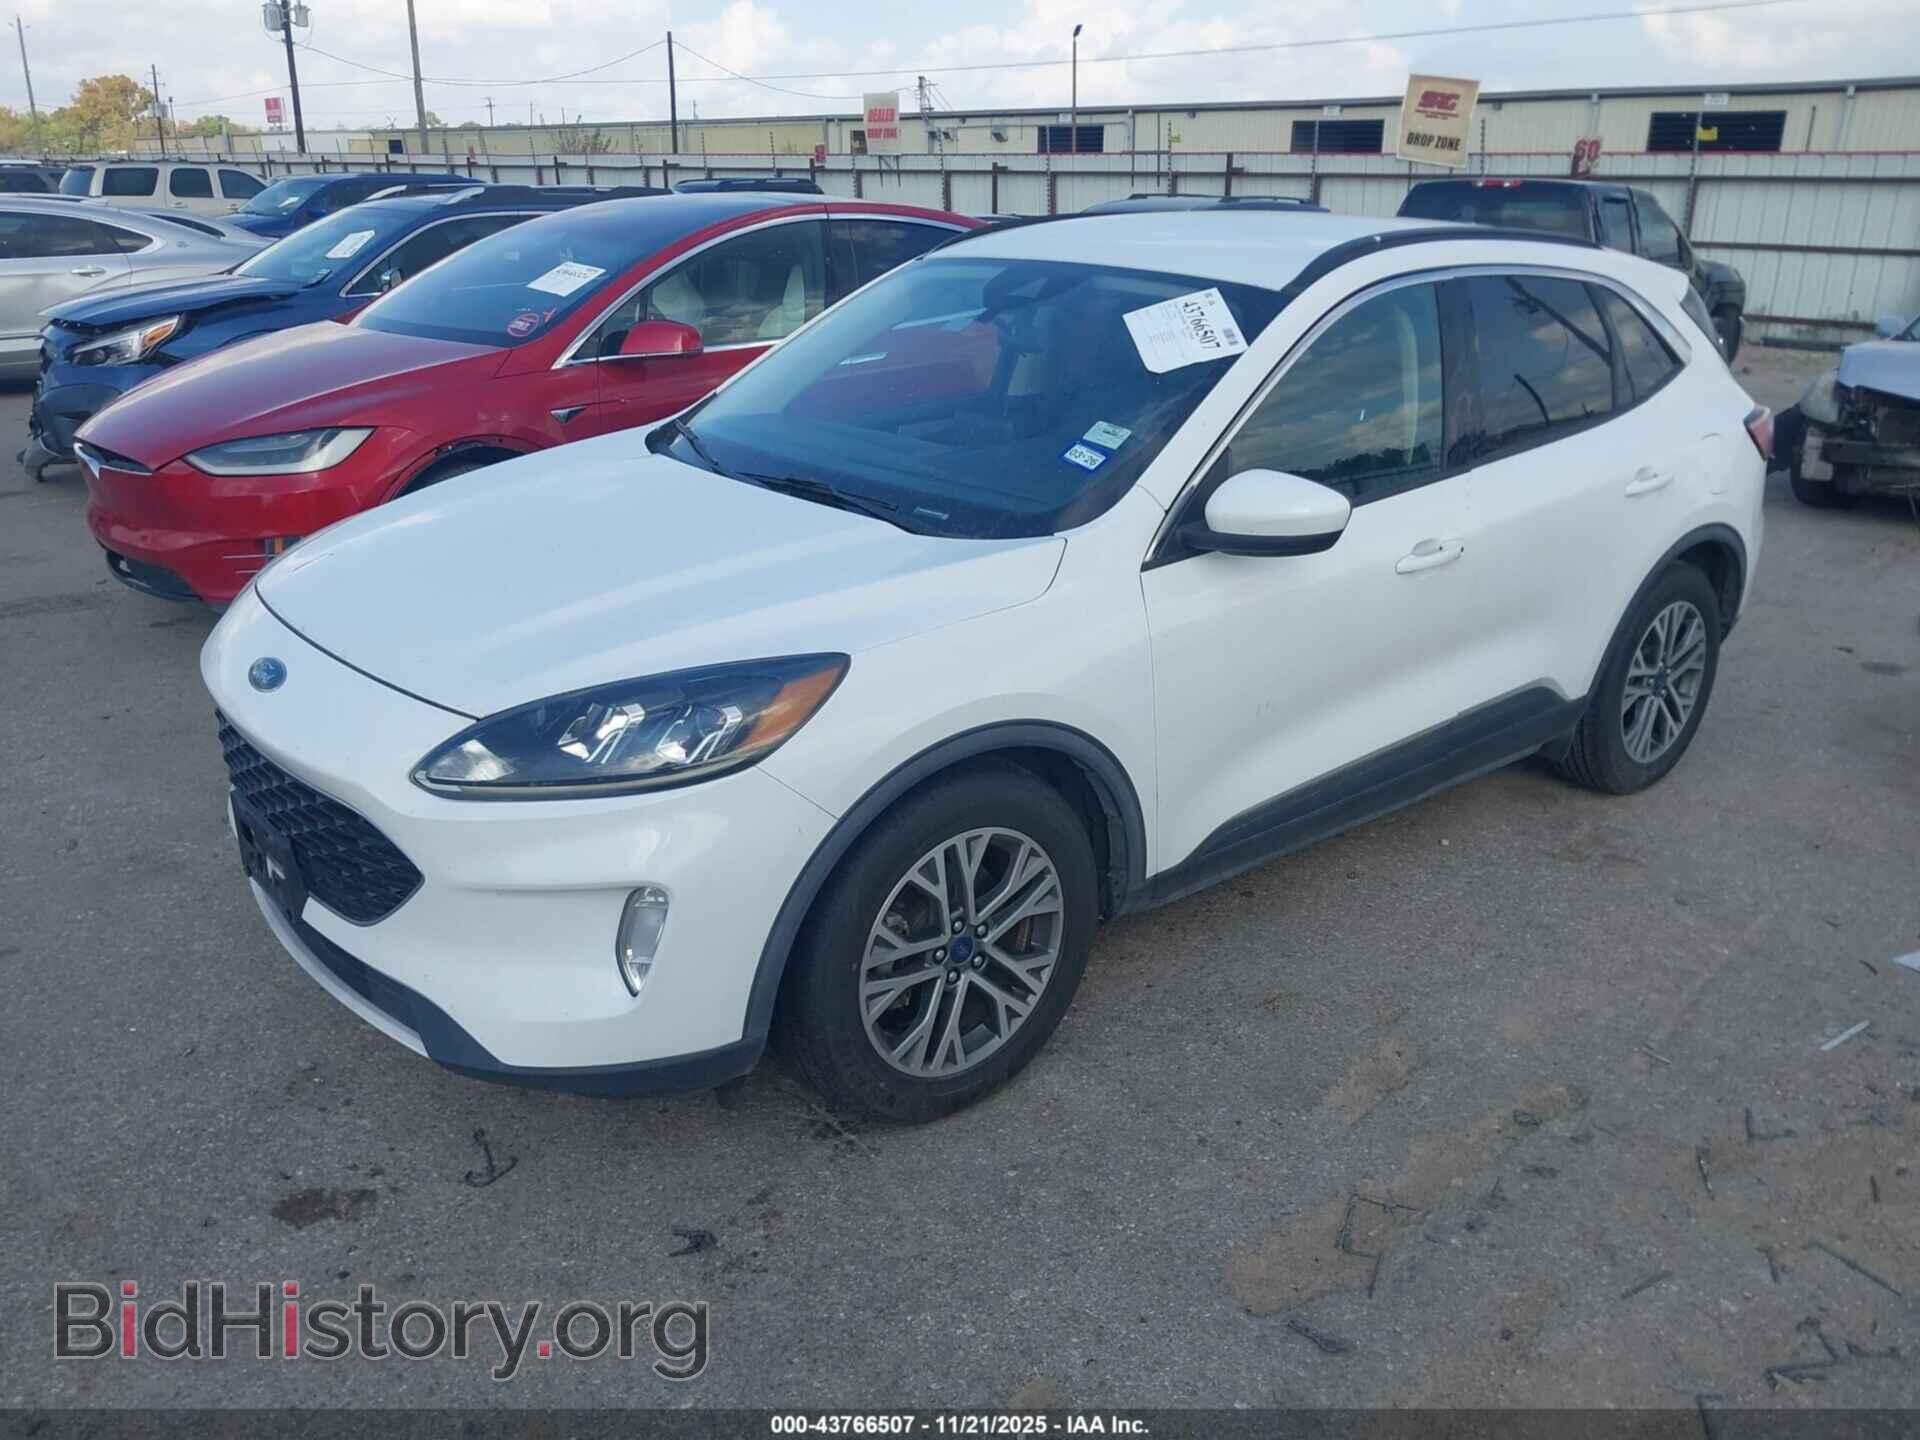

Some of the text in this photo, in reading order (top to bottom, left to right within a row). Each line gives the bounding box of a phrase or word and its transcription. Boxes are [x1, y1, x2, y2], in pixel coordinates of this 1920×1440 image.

[1407, 132, 1461, 151] DROP ZONE
[1183, 301, 1221, 349] 43766507
